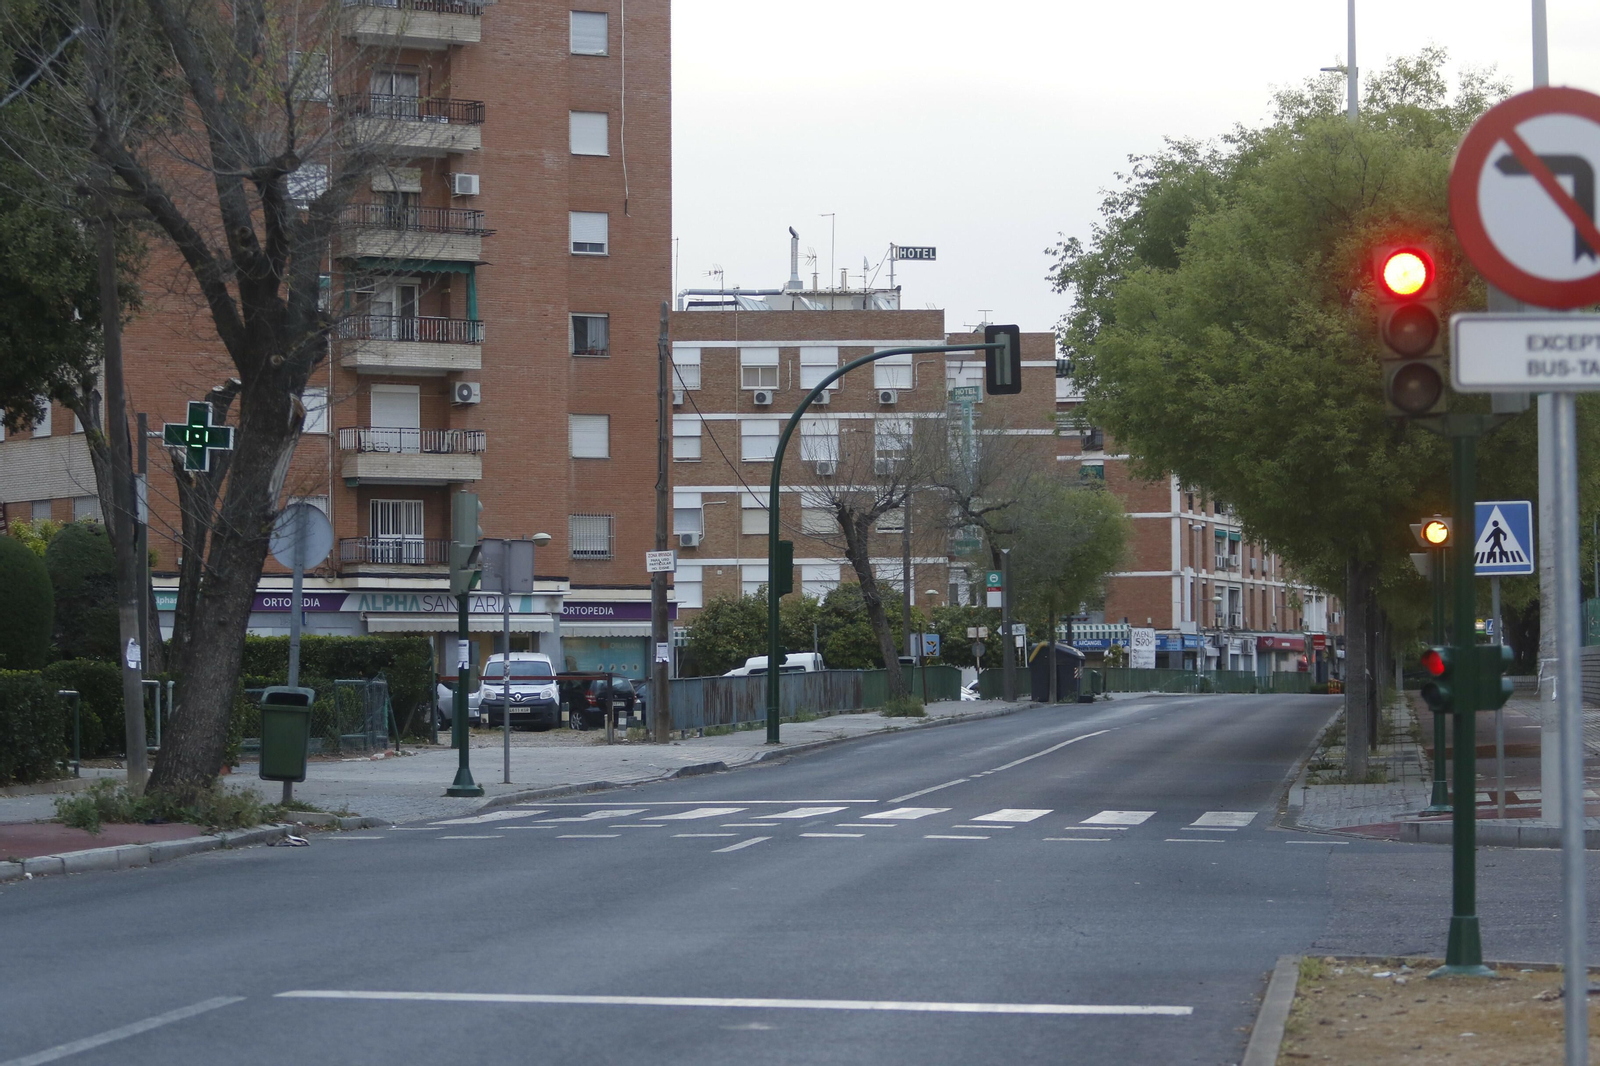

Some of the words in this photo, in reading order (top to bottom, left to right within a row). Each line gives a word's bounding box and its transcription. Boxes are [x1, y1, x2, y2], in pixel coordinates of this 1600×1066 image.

[900, 248, 936, 258] HOTEL
[263, 597, 320, 607] ORTOEDIA
[422, 595, 514, 612] SANTARIA
[562, 606, 614, 615] ORTOPEDIA
